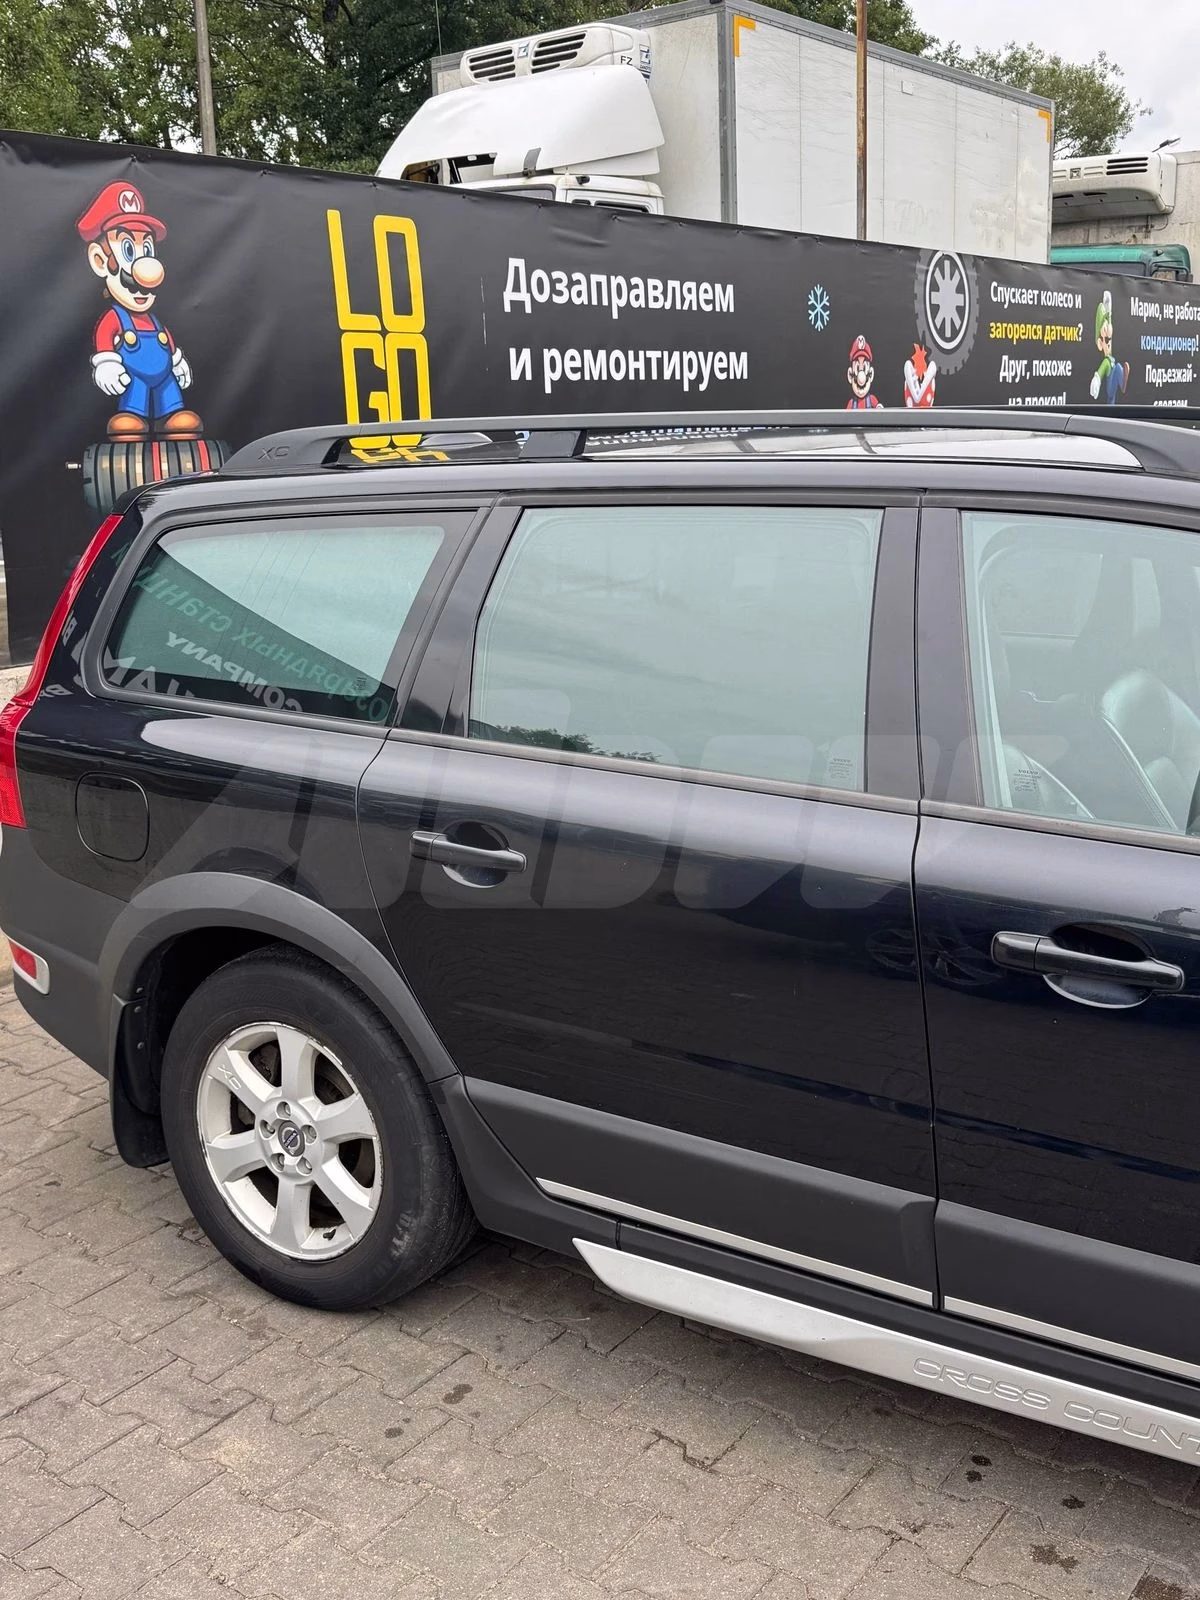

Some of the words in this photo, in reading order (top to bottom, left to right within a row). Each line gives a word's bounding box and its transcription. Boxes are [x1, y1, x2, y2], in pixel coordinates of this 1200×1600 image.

[503, 257, 735, 319] Дозаправляем
[990, 281, 1039, 309] Спускает
[1041, 290, 1073, 308] колесо
[1075, 294, 1082, 309] и
[1130, 297, 1162, 323] Марио,
[1163, 303, 1174, 320] не
[989, 322, 1042, 345] загорелся
[1044, 323, 1083, 345] датчик?
[1141, 334, 1199, 357] кондиционер!
[509, 347, 532, 381] и
[543, 348, 748, 394] ремонтируем
[1000, 355, 1030, 383] Друг,
[1033, 359, 1072, 377] похоже
[1145, 363, 1192, 388] Подъезжай
[257, 445, 291, 462] XC
[912, 1357, 1051, 1410] CROSS
